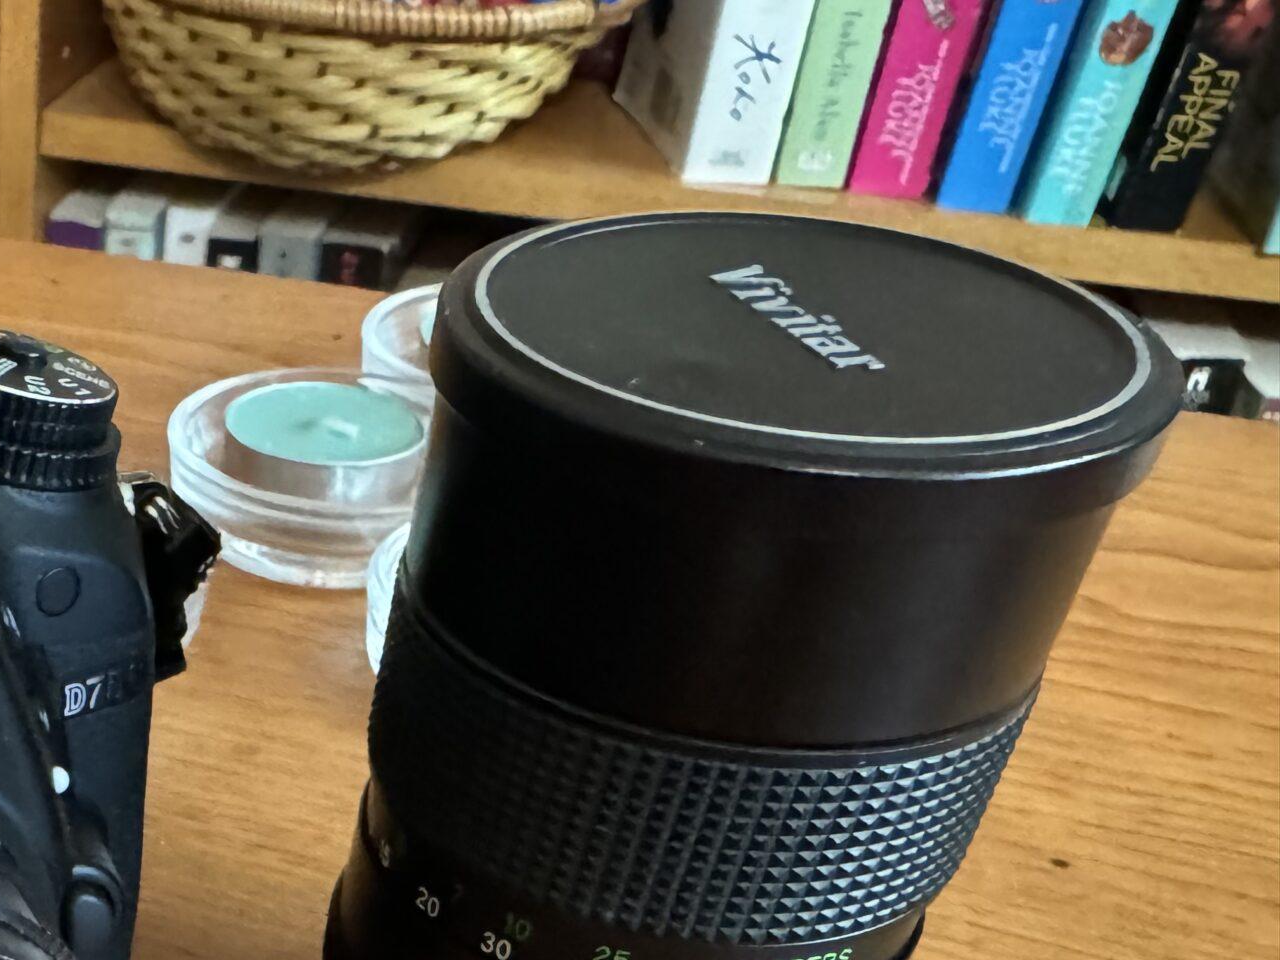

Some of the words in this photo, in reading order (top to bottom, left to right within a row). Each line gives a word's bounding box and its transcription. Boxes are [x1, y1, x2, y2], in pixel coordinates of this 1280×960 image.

[1150, 52, 1219, 172] APPEAL
[1181, 69, 1240, 160] FINAL
[708, 264, 886, 370] Vivitar
[24, 375, 51, 396] U2
[415, 886, 440, 918] 20
[480, 931, 512, 960] 30
